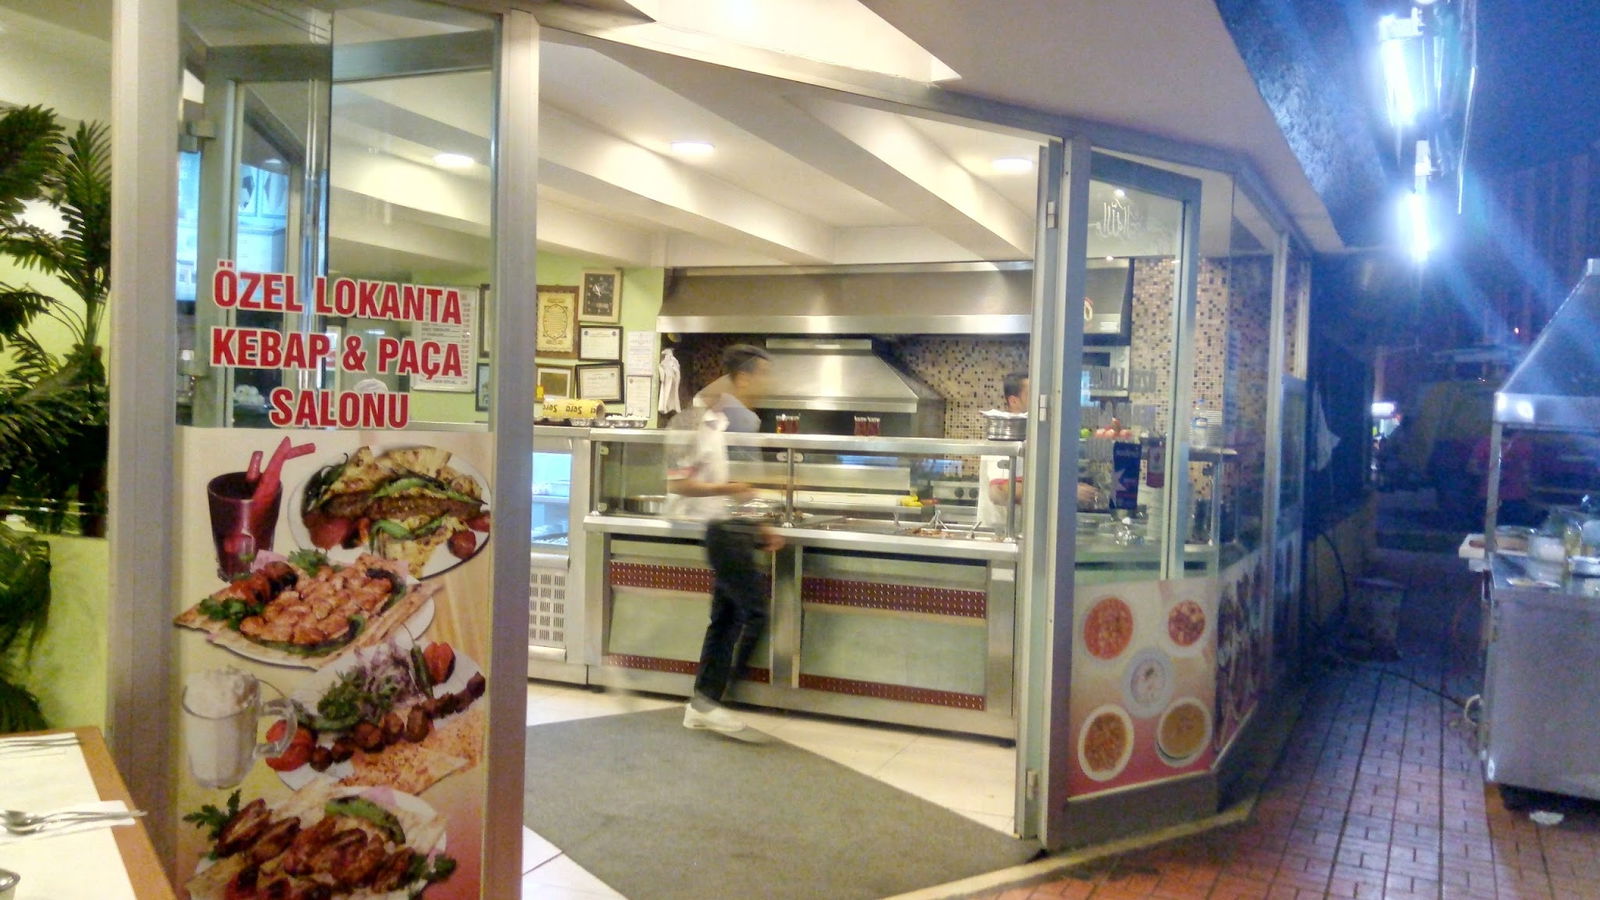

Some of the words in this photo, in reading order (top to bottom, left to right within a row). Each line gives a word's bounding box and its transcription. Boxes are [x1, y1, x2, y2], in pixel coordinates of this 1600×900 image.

[213, 260, 303, 312] ÖZEL
[316, 278, 462, 325] LOKANTA
[213, 328, 330, 369] KEBAP
[342, 335, 366, 371] &
[378, 338, 462, 379] PAÇA
[271, 388, 408, 429] SALONU
